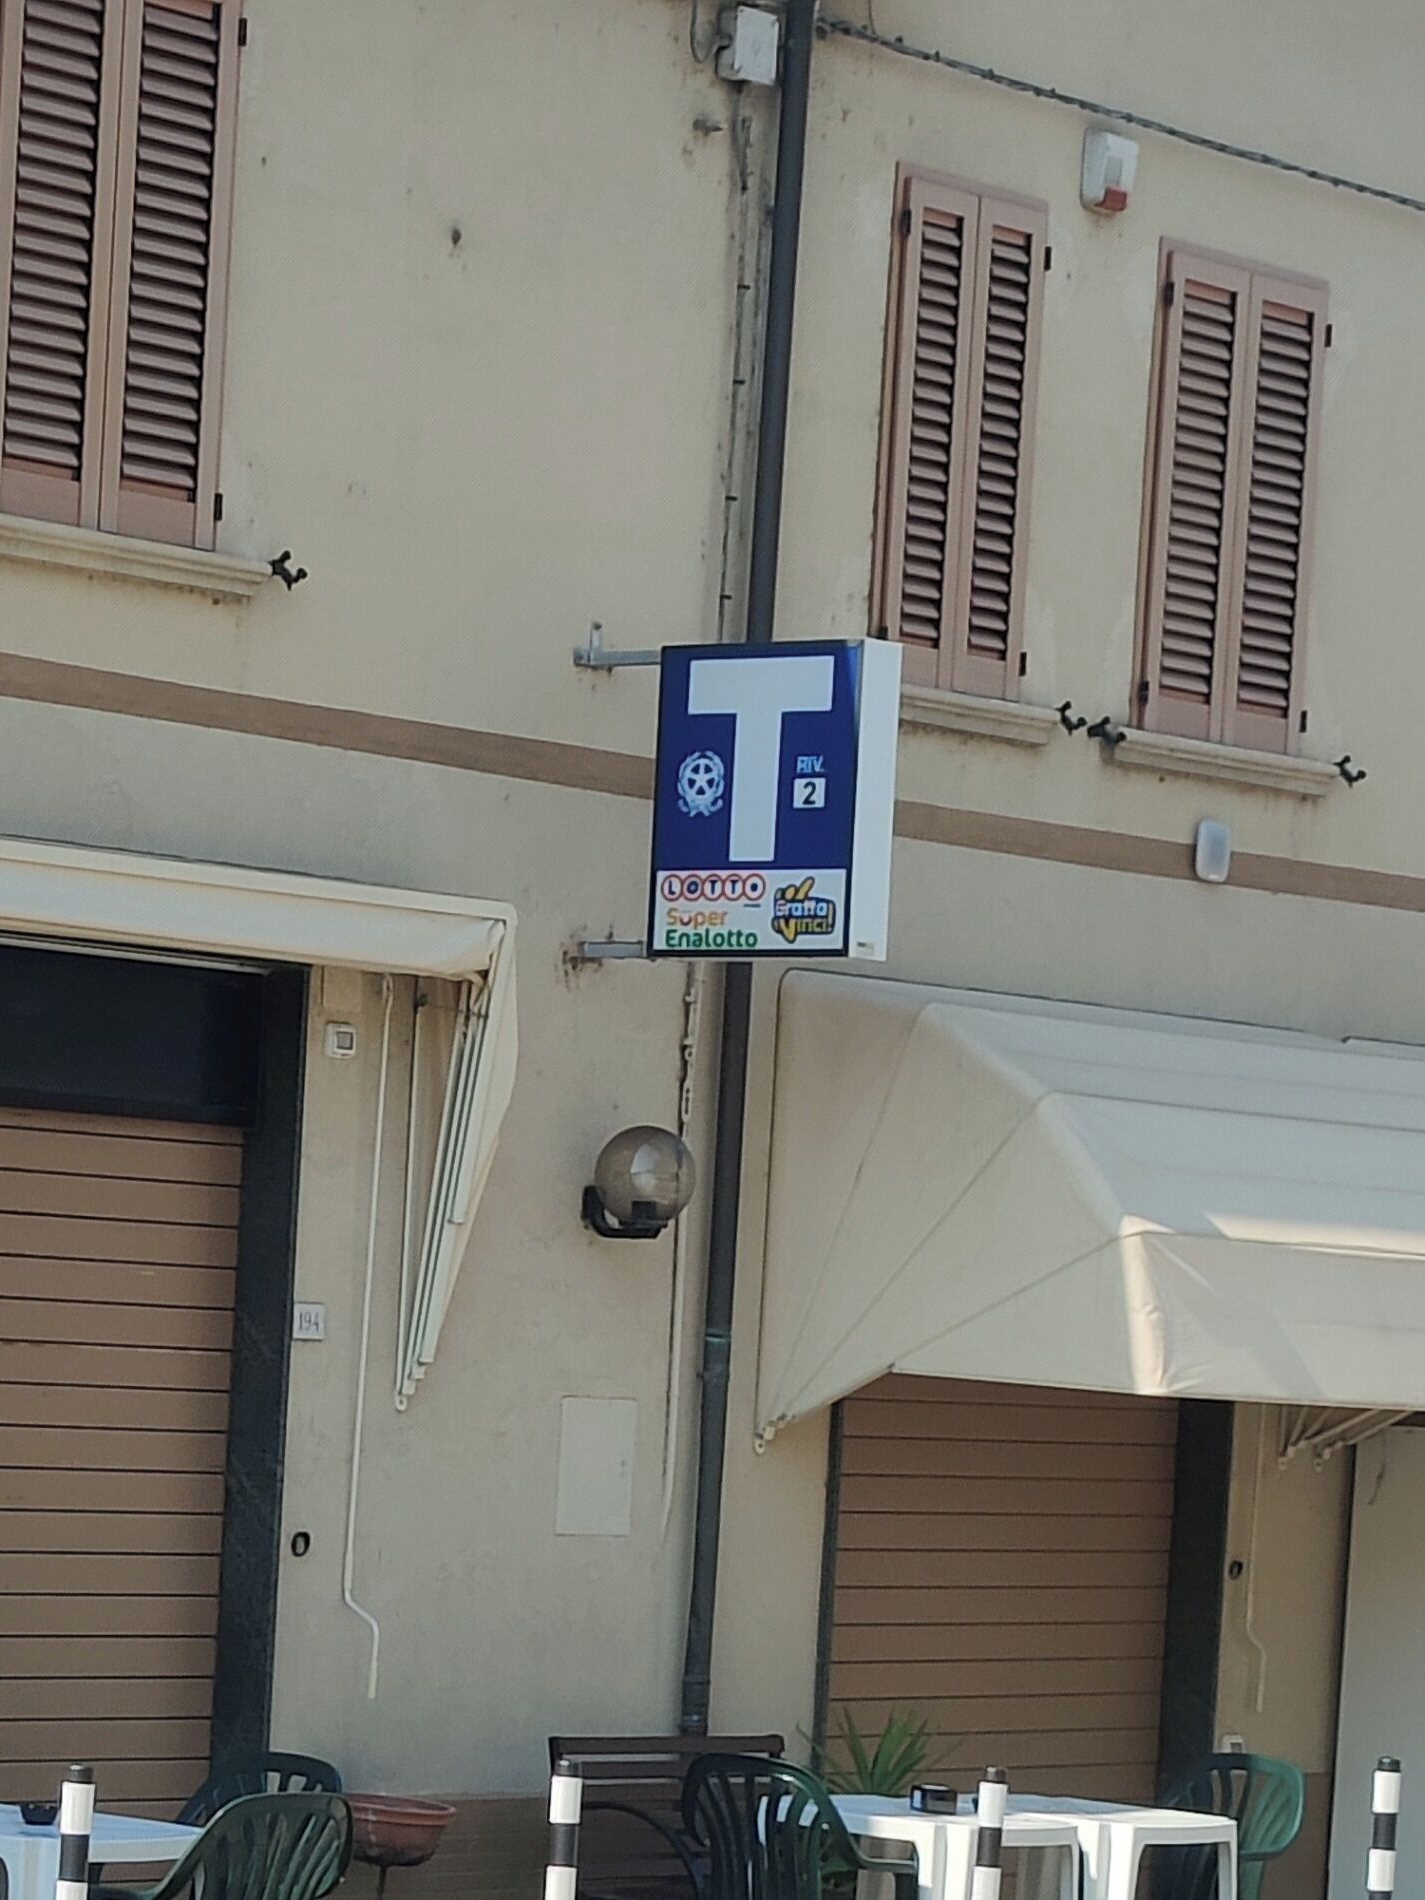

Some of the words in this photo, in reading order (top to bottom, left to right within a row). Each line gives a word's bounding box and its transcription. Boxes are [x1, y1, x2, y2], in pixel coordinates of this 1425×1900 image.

[688, 655, 834, 862] T
[796, 755, 824, 773] RIV.
[802, 781, 817, 805] 2
[663, 875, 764, 899] LOTTO
[666, 907, 728, 930] Super
[664, 927, 759, 948] Enalotto
[298, 1311, 320, 1332] 194
